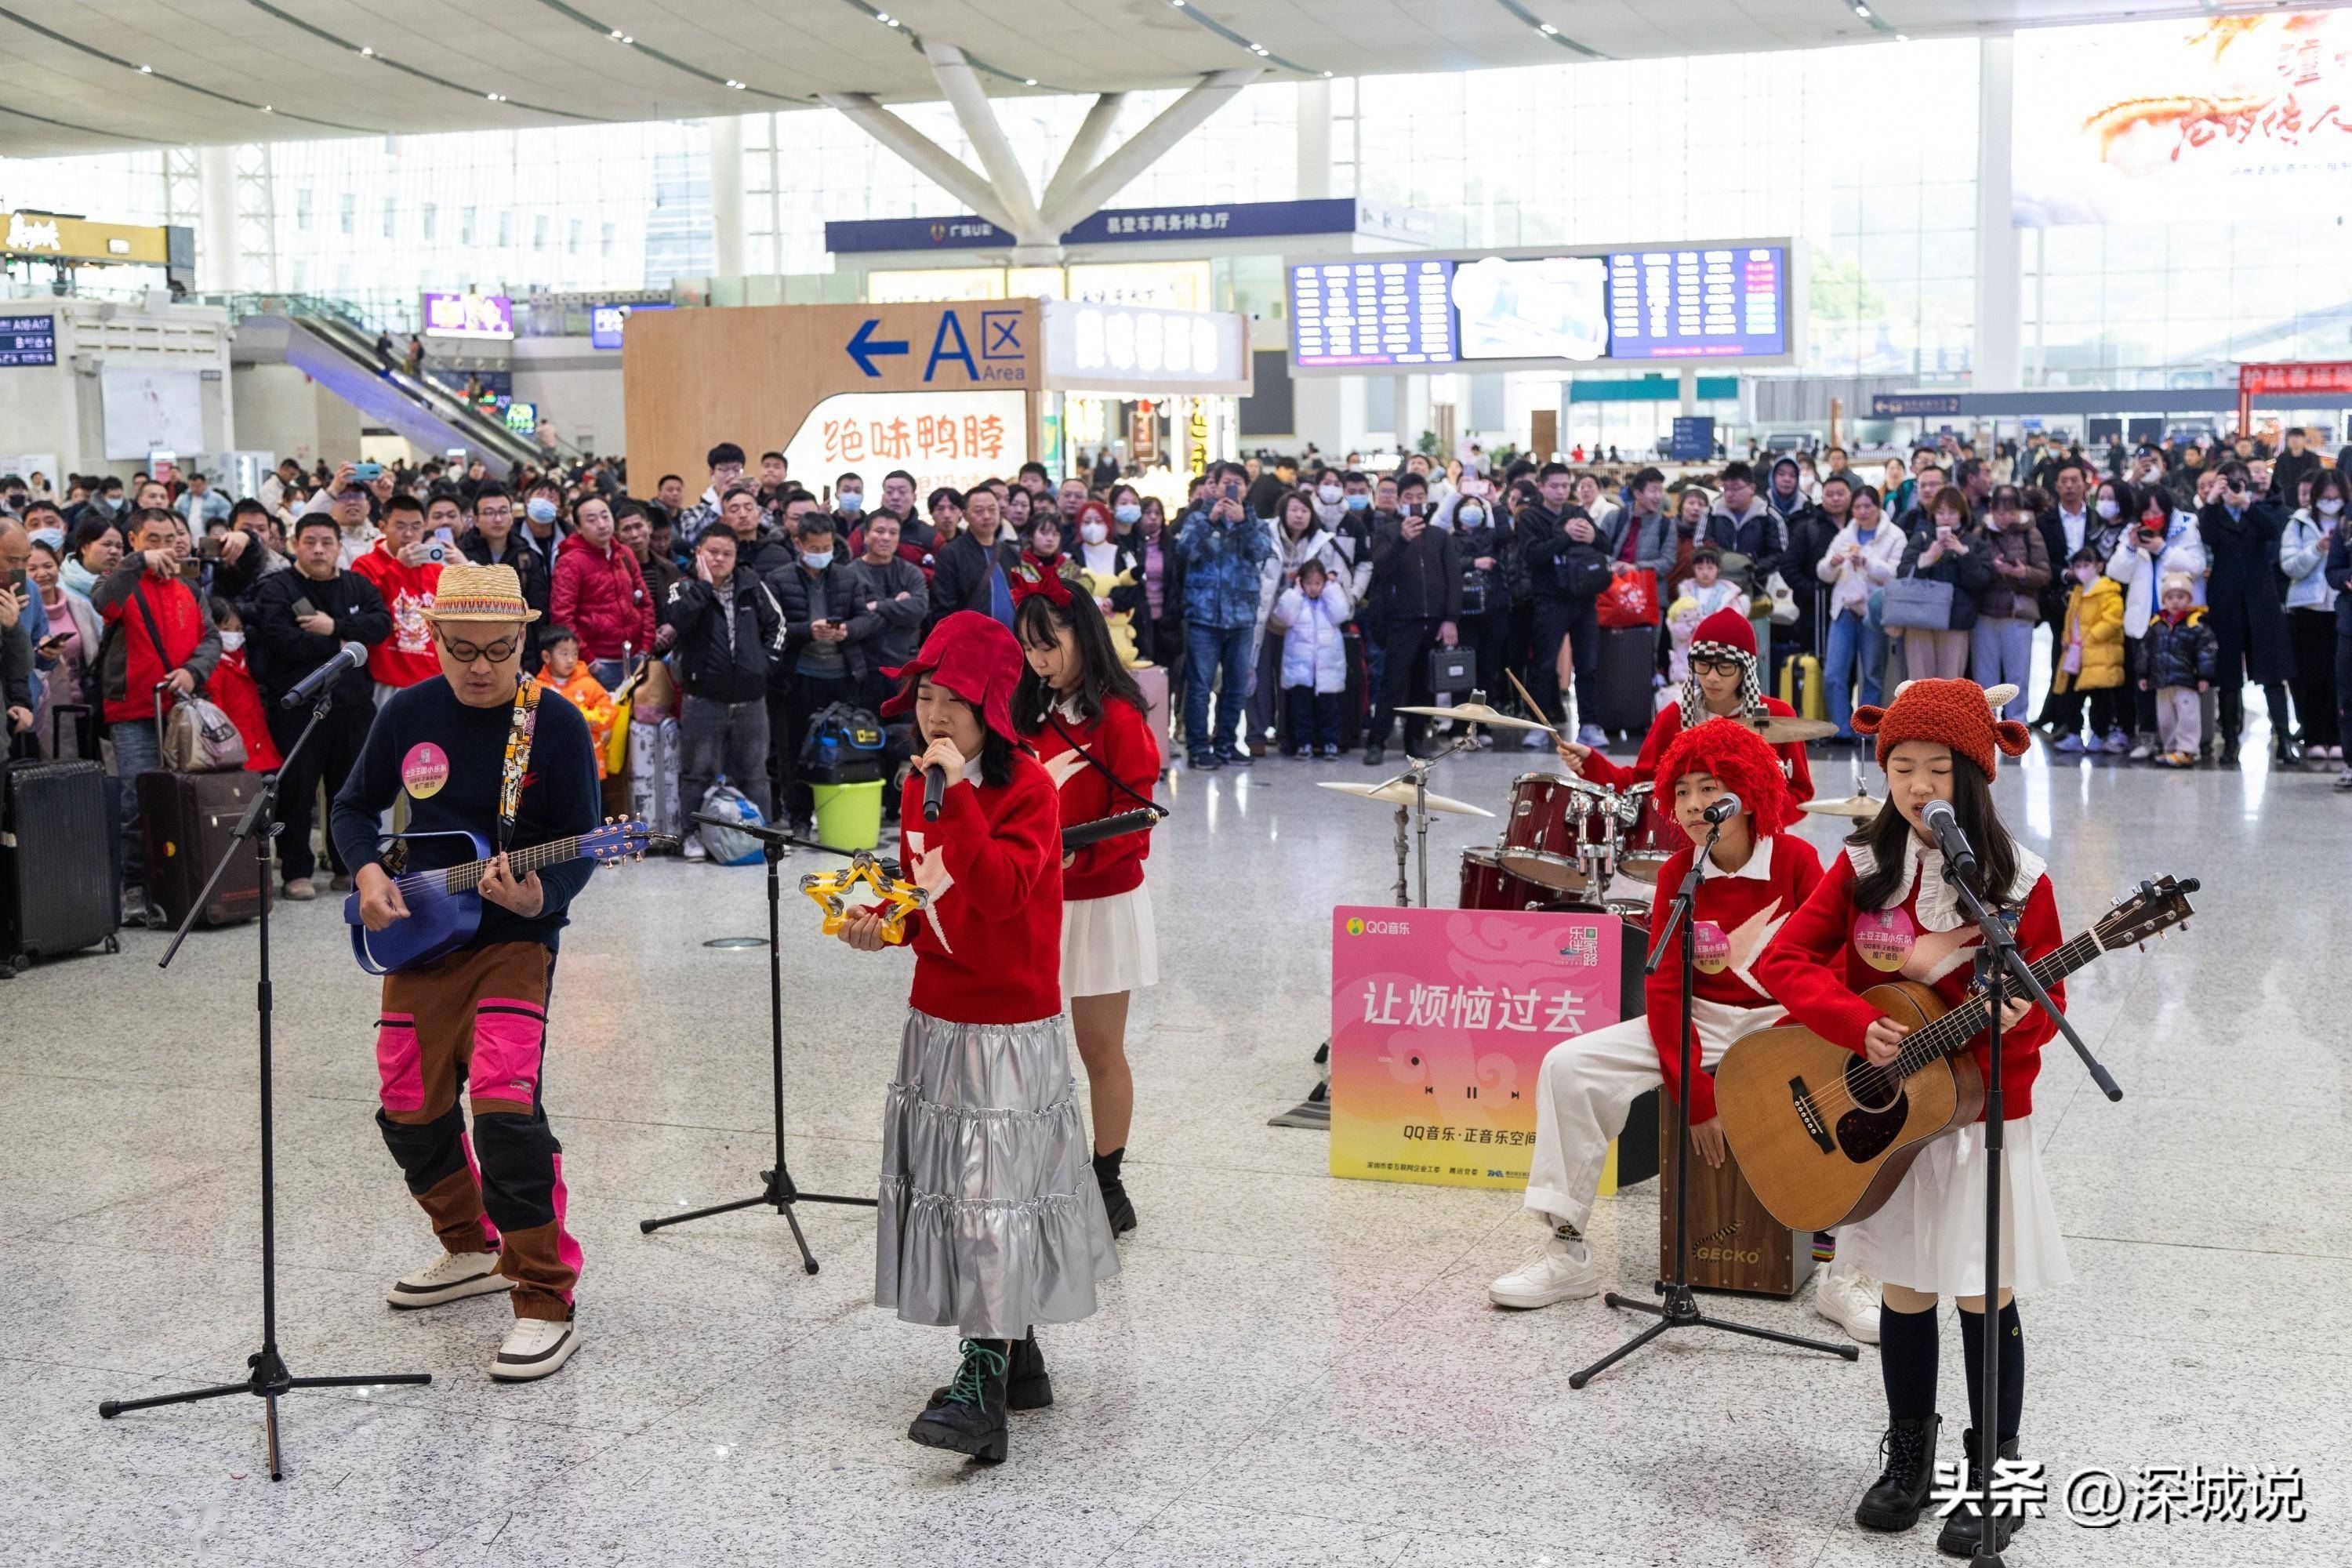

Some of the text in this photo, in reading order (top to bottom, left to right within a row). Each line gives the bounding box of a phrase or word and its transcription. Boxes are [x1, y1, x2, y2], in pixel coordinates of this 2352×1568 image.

[983, 365, 1025, 381] Area
[823, 413, 1005, 463] 绝味鸭脖
[1367, 920, 1410, 935] QQ音乐
[1857, 931, 1912, 945] 土豆王国小乐队
[1363, 980, 1588, 1035] 让烦恼过去
[1697, 1247, 1759, 1265] GECKO
